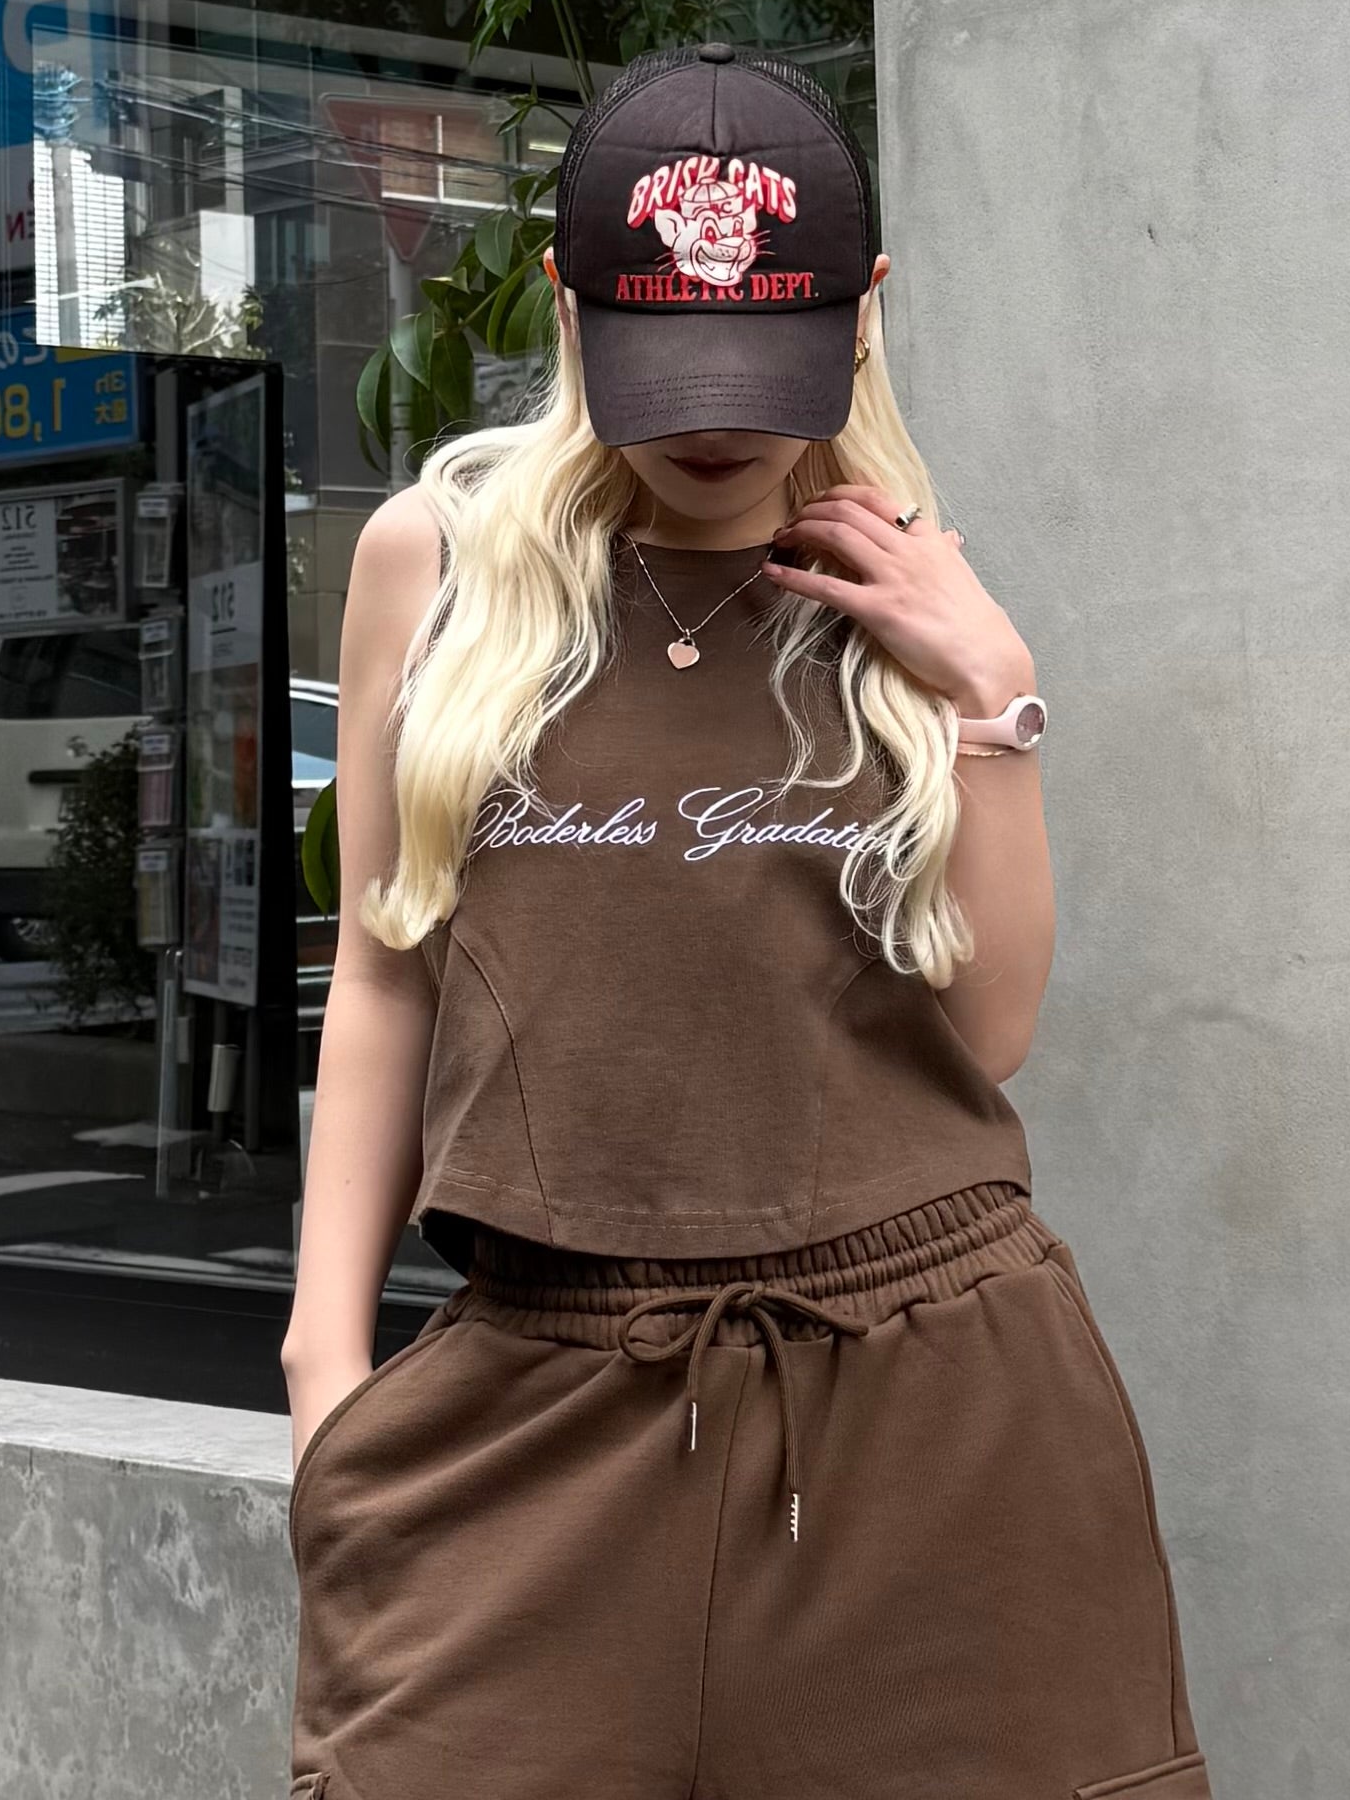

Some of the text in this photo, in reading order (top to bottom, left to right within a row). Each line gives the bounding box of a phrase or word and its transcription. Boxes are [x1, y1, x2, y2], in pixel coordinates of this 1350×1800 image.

[728, 157, 797, 224] CATS
[751, 271, 819, 301] DEPT.
[471, 788, 658, 855] Boderless
